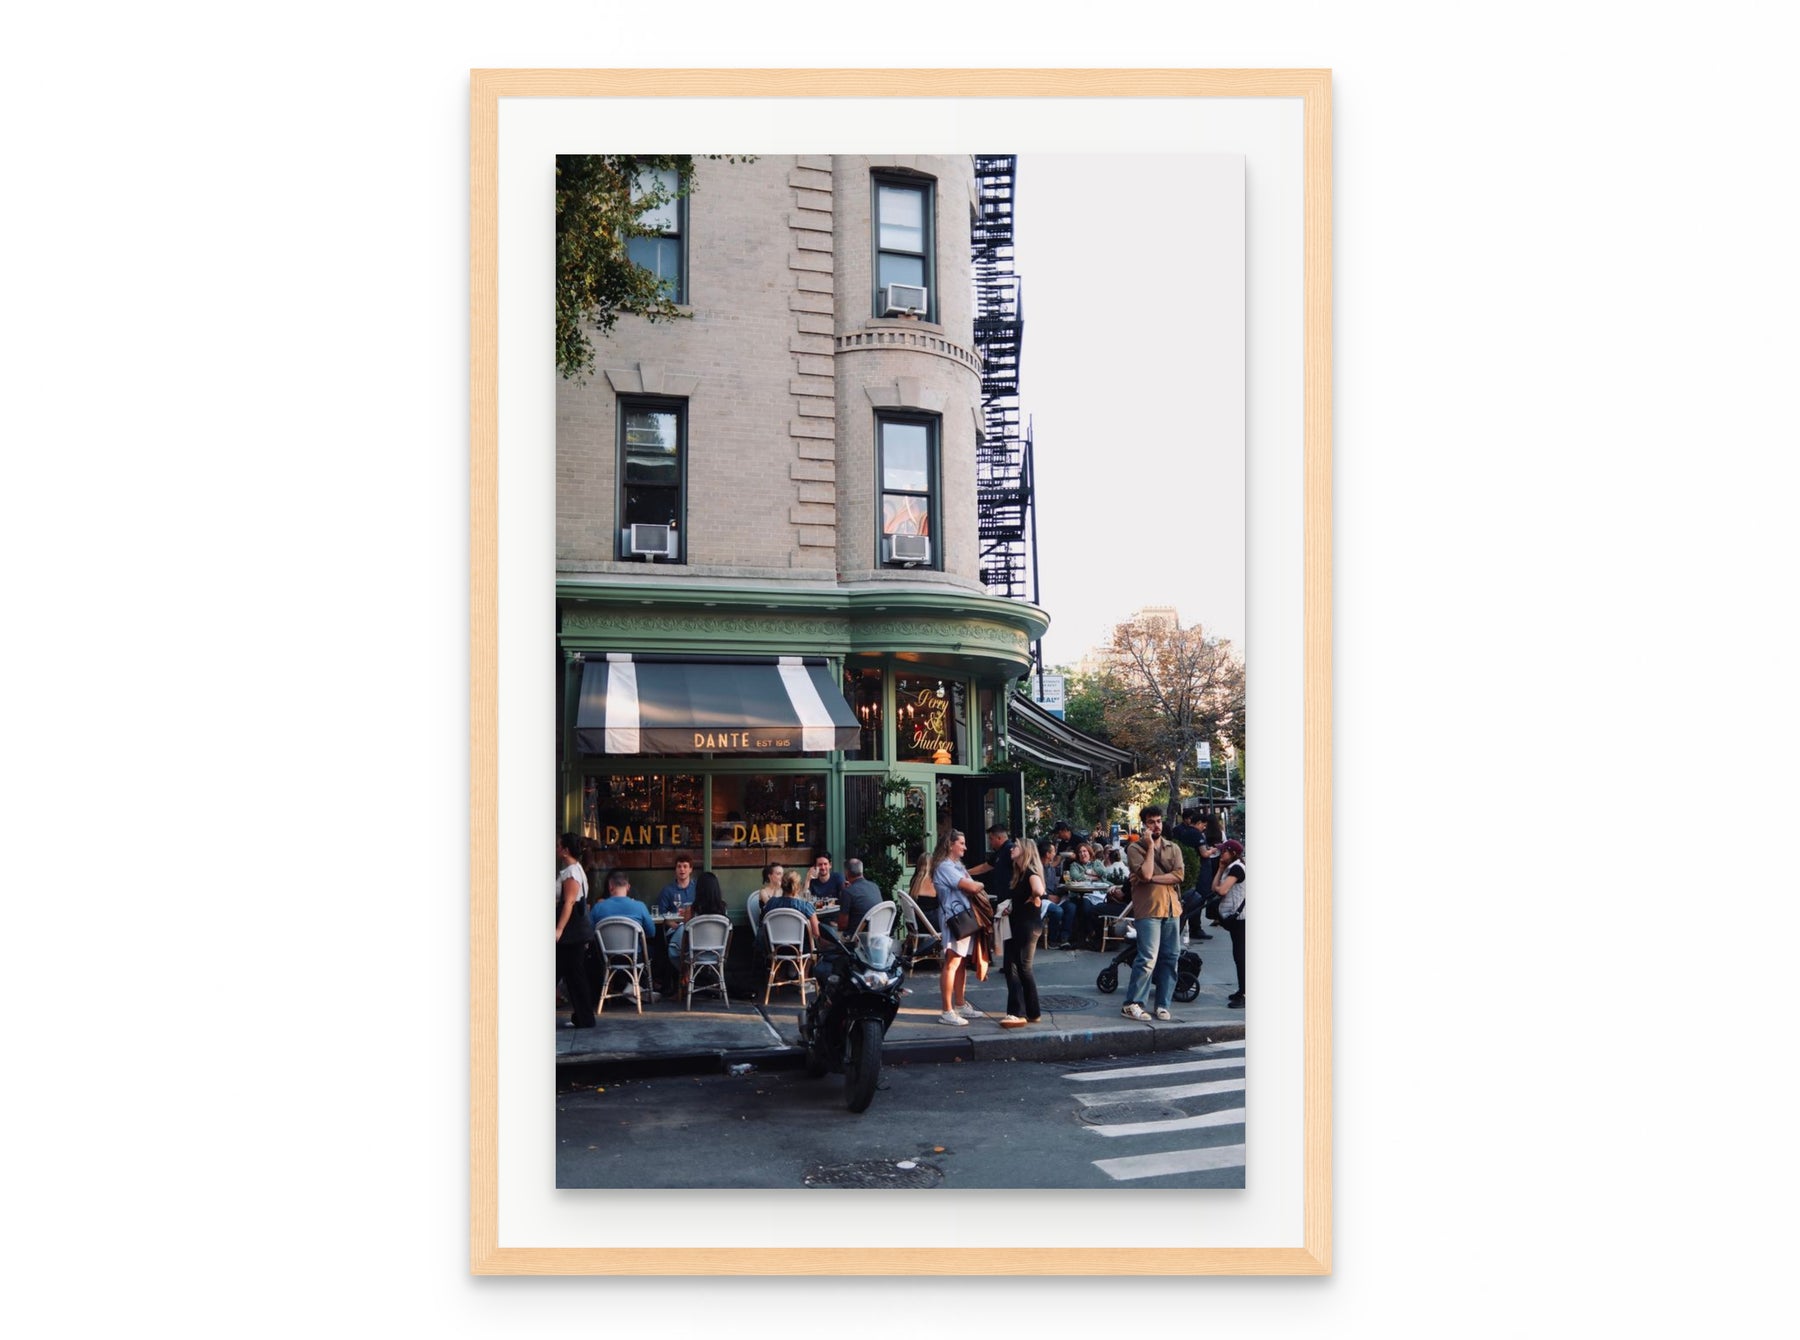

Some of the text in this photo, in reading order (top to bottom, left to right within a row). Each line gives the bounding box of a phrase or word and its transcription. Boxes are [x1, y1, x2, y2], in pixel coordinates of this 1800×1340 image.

[914, 689, 949, 719] Perry
[924, 711, 943, 734] &
[694, 732, 749, 748] DANTE
[775, 739, 791, 747] 1915
[908, 730, 955, 751] Hudson
[605, 825, 681, 845] DANTE
[733, 823, 806, 843] DANTE
